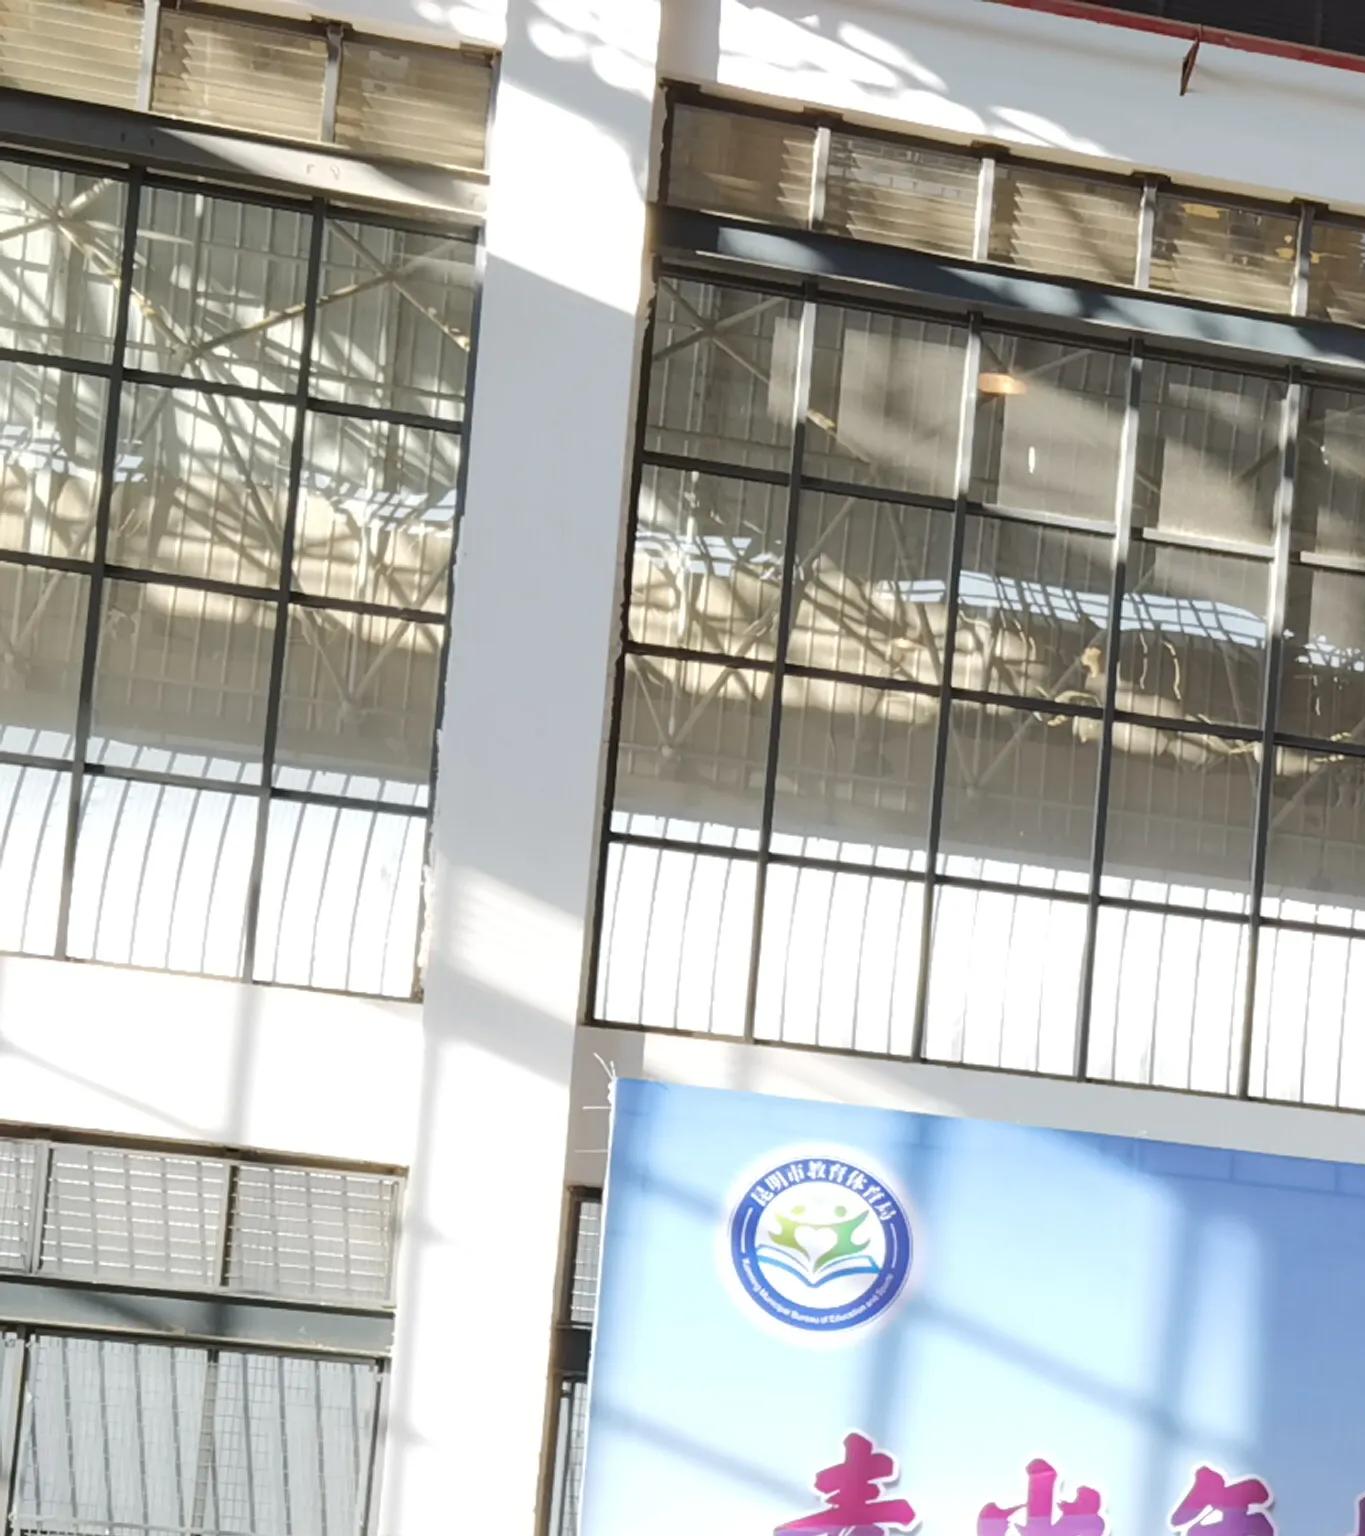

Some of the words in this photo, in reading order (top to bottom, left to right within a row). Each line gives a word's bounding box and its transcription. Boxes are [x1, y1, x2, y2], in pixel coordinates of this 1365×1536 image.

[750, 1160, 897, 1222] 昆明市教育体育局
